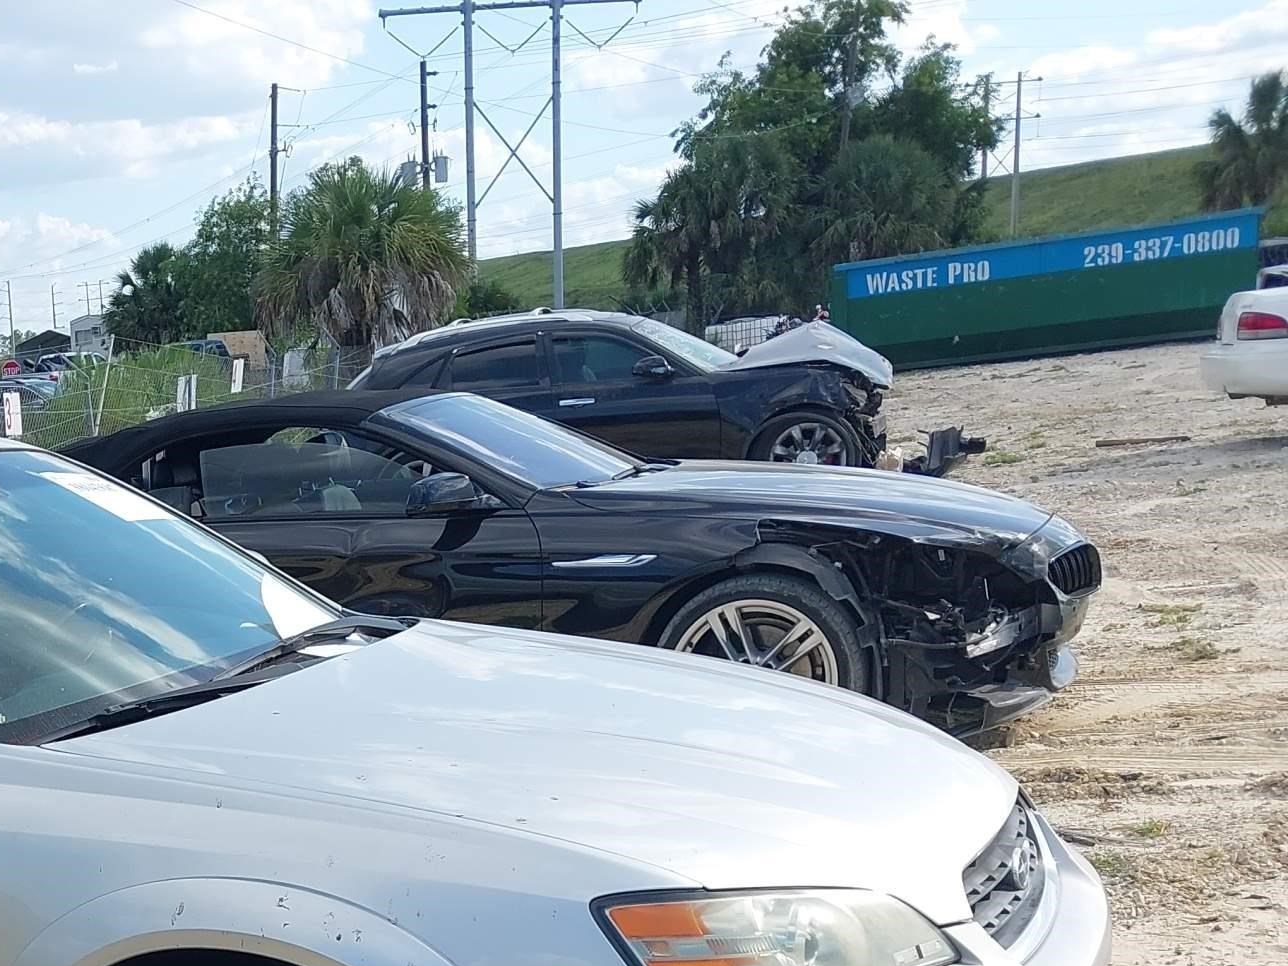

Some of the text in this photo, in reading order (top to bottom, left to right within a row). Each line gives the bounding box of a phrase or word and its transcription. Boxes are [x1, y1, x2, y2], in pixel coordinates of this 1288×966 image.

[866, 226, 1240, 294] WASTE PRO 239-337-0800
[3, 366, 20, 376] STOP
